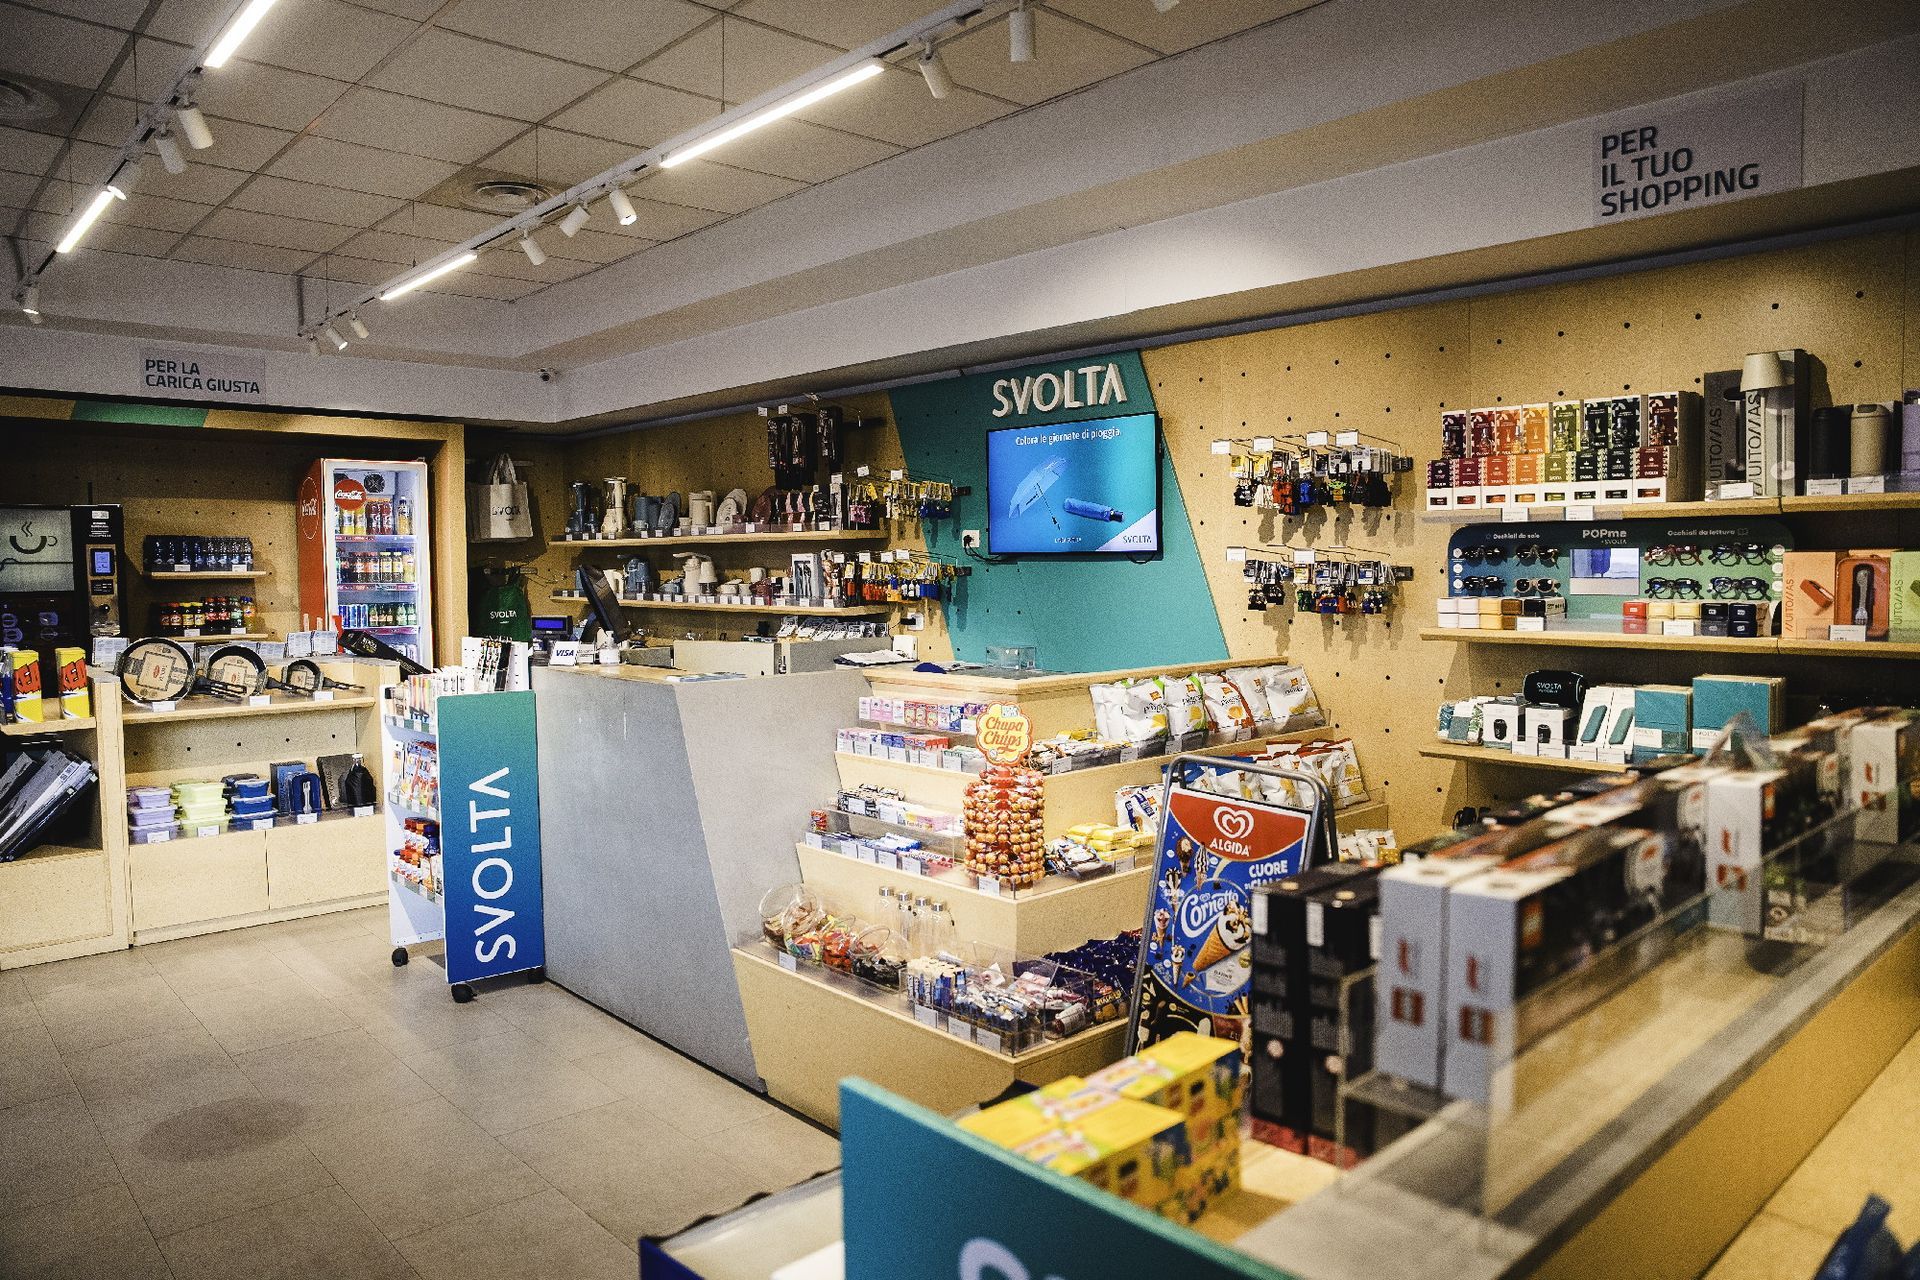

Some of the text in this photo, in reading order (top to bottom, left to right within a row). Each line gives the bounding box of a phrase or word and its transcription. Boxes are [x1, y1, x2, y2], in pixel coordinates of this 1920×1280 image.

[1601, 125, 1658, 159] PER
[1601, 147, 1693, 188] IL TUO
[1600, 163, 1760, 217] SHOPPING
[145, 359, 200, 375] PER LA
[145, 374, 260, 394] CARICA GIUSTA
[992, 362, 1128, 418] SVOLTA
[1015, 426, 1120, 446] Colora le giornate di pioggia
[1122, 535, 1152, 544] SVOLTA
[1582, 528, 1627, 539] POPme
[489, 610, 518, 620] SVOLTA
[555, 649, 575, 657] VISA
[1536, 681, 1562, 690] SVOLTA
[985, 716, 1024, 734] Chupa
[983, 730, 1022, 754] Chups
[1209, 837, 1250, 857] ALGIDA
[468, 766, 517, 963] SVOLTA
[1248, 859, 1288, 879] CUORE
[1180, 889, 1240, 939] Cornetto
